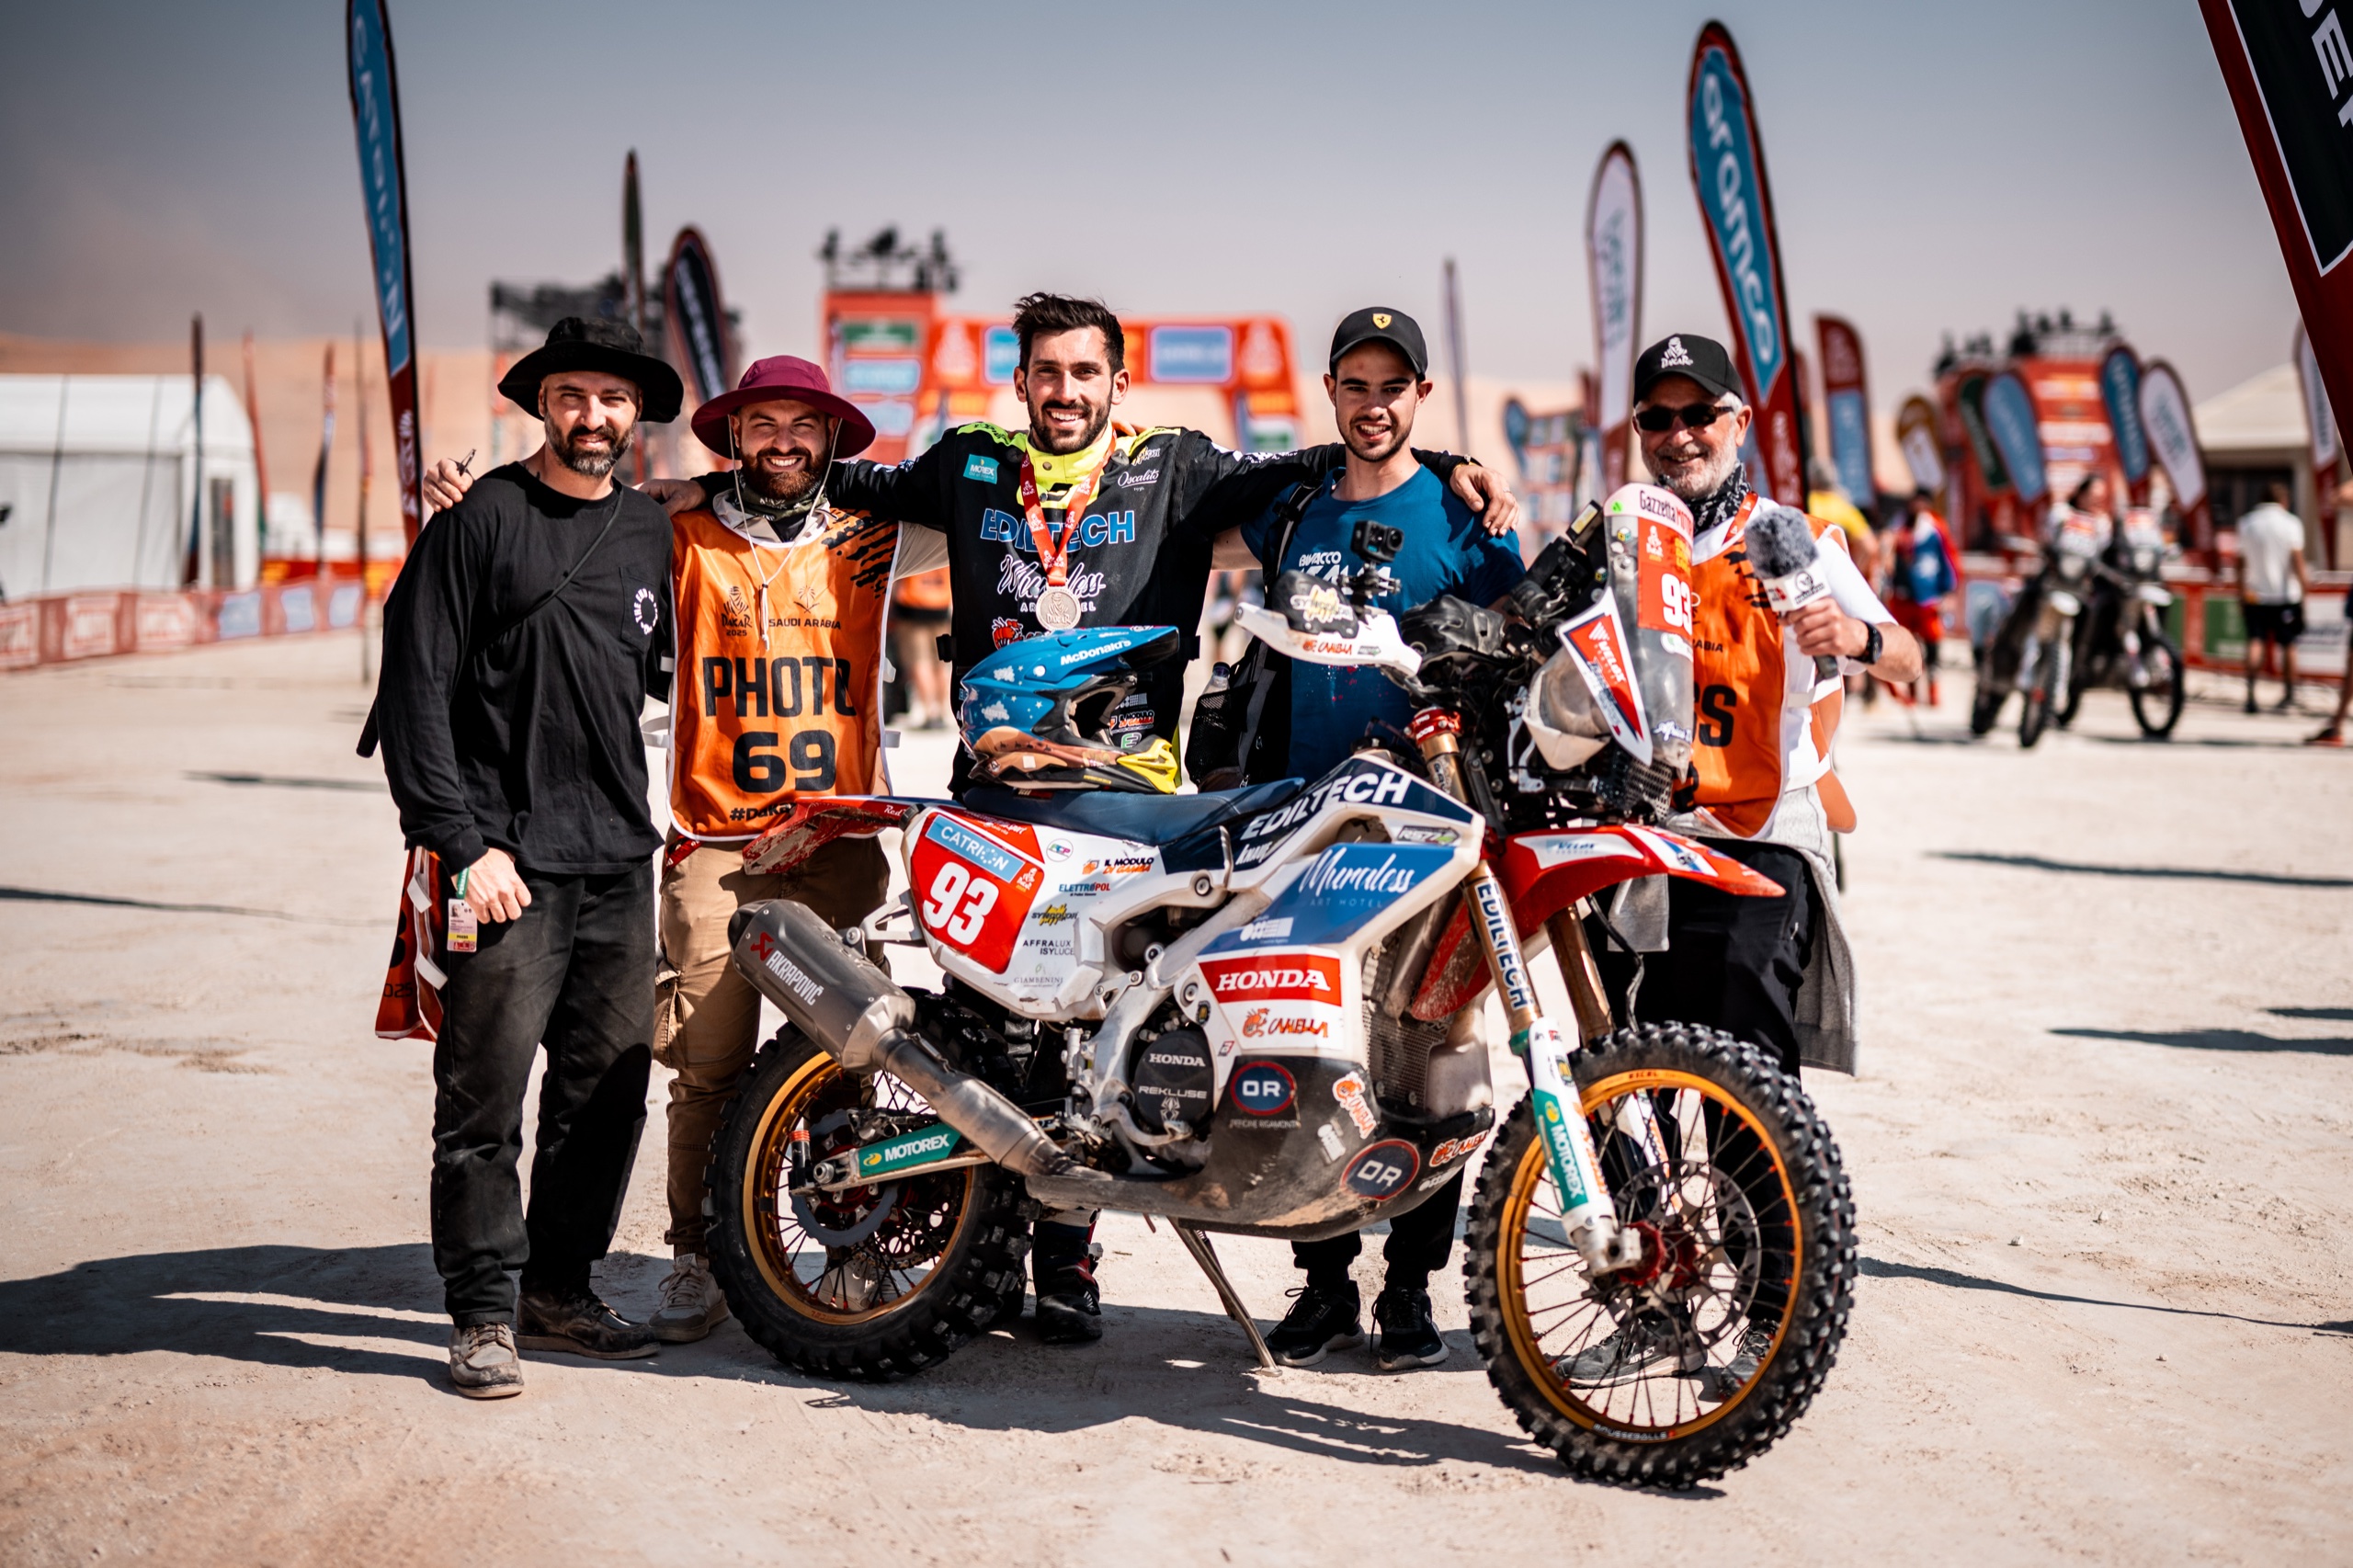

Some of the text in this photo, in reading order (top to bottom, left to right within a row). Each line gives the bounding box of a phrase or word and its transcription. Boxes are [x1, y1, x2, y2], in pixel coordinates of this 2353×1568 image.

[1703, 72, 1774, 364] aramco
[1118, 470, 1159, 486] Oscalito
[1299, 552, 1342, 567] BIVACCO
[1661, 573, 1693, 636] 93
[768, 618, 841, 630] SAUDI ARABIA
[1061, 639, 1131, 665] McDonald's
[702, 655, 858, 718] PHOTO
[733, 730, 836, 794] 69
[1240, 771, 1413, 841] EDILTECH
[1114, 857, 1154, 867] MODULO
[1298, 846, 1416, 897] Muraless
[922, 861, 999, 946] 93
[1310, 897, 1383, 908] ART HOTEL
[1023, 939, 1072, 948] AFFRALUX
[1040, 948, 1074, 956] ISYLUCE
[1474, 881, 1534, 1011] EDILTECH
[765, 949, 825, 1006] AKRAPOVIČ
[1215, 969, 1331, 992] HONDA
[1149, 1053, 1206, 1067] HONDA
[1138, 1085, 1208, 1099] REKLUSE
[1242, 1080, 1282, 1097] OR
[884, 1133, 950, 1162] MOTOREX
[1550, 1123, 1586, 1199] MOTOREX
[1357, 1159, 1403, 1187] OR
